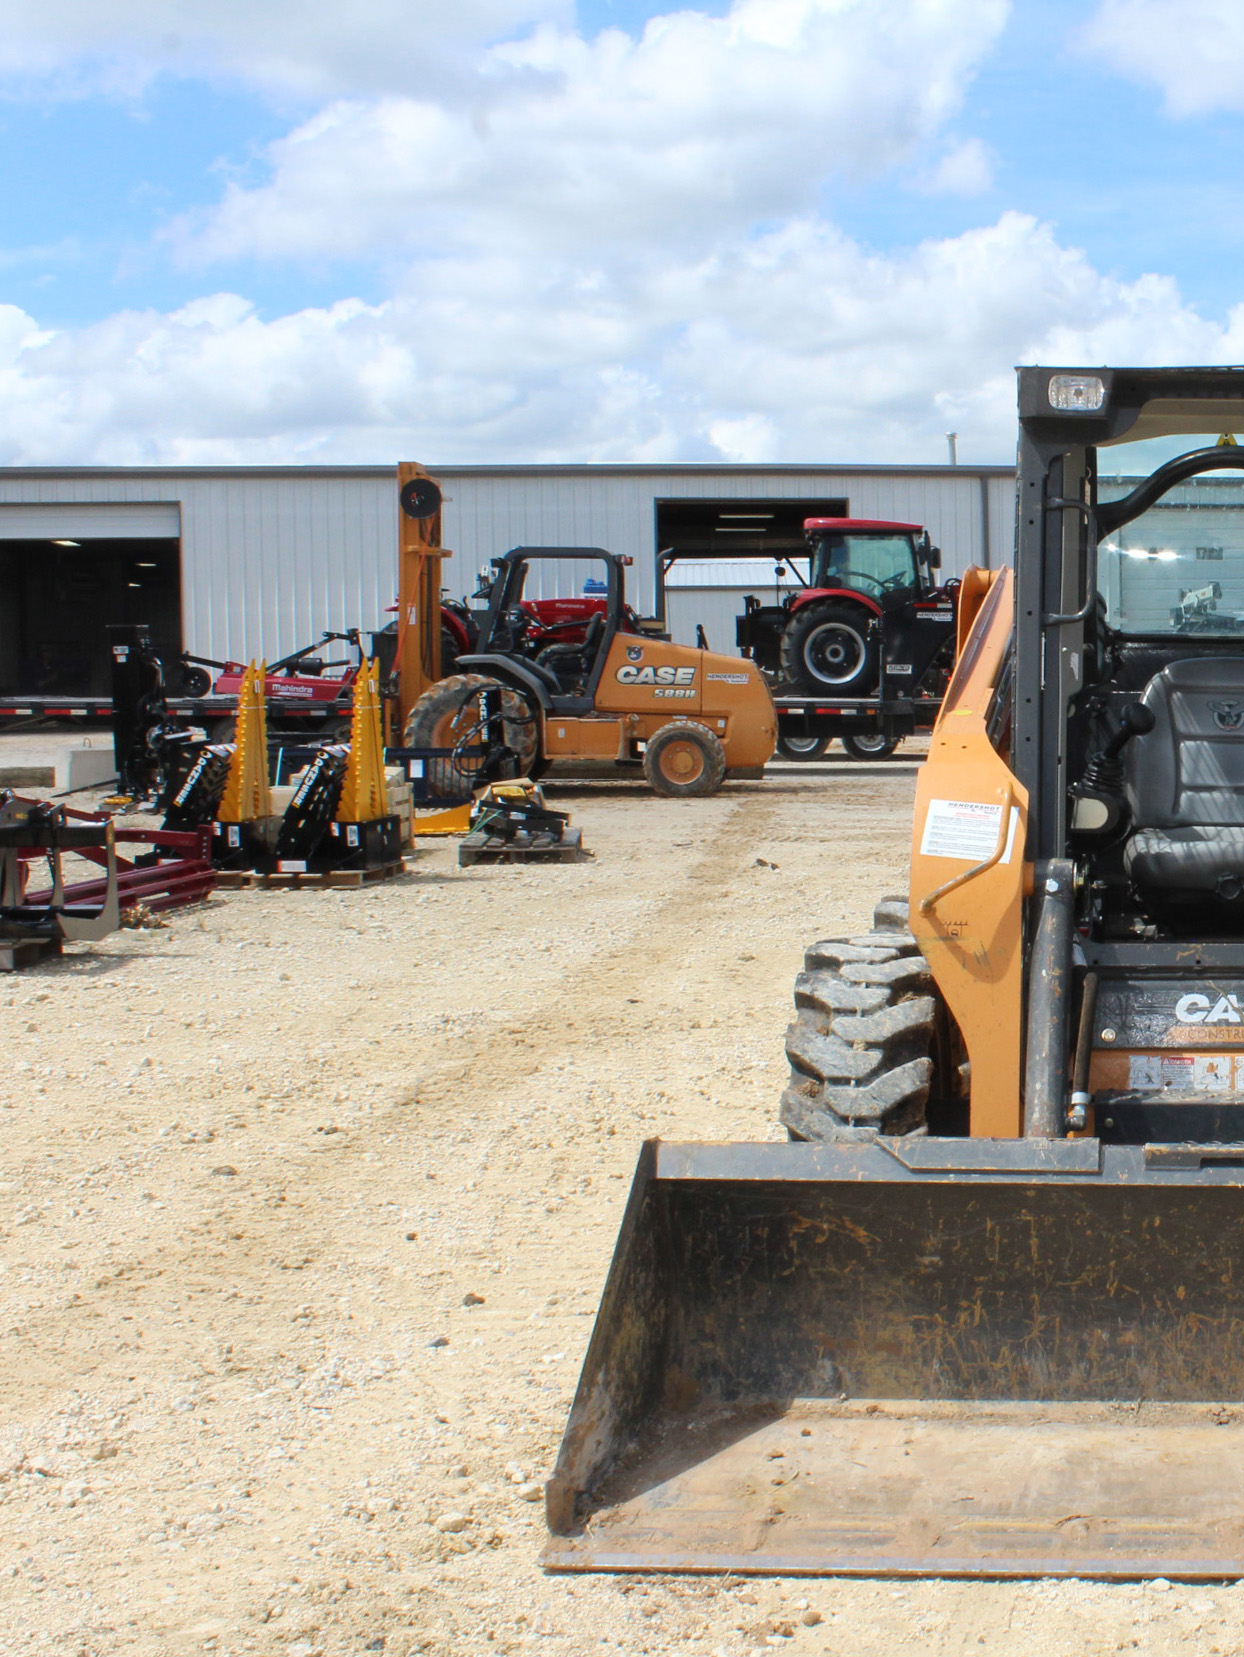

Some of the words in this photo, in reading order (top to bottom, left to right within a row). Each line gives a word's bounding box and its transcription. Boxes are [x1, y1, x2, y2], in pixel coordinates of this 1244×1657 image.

[615, 665, 696, 686] CASE
[272, 684, 313, 693] Mahindra
[653, 689, 696, 698] 588H
[478, 698, 489, 741] DANER
[175, 756, 207, 806] DANUSER
[292, 757, 324, 807] DANUSER
[948, 802, 1001, 811] HENDERSHOT
